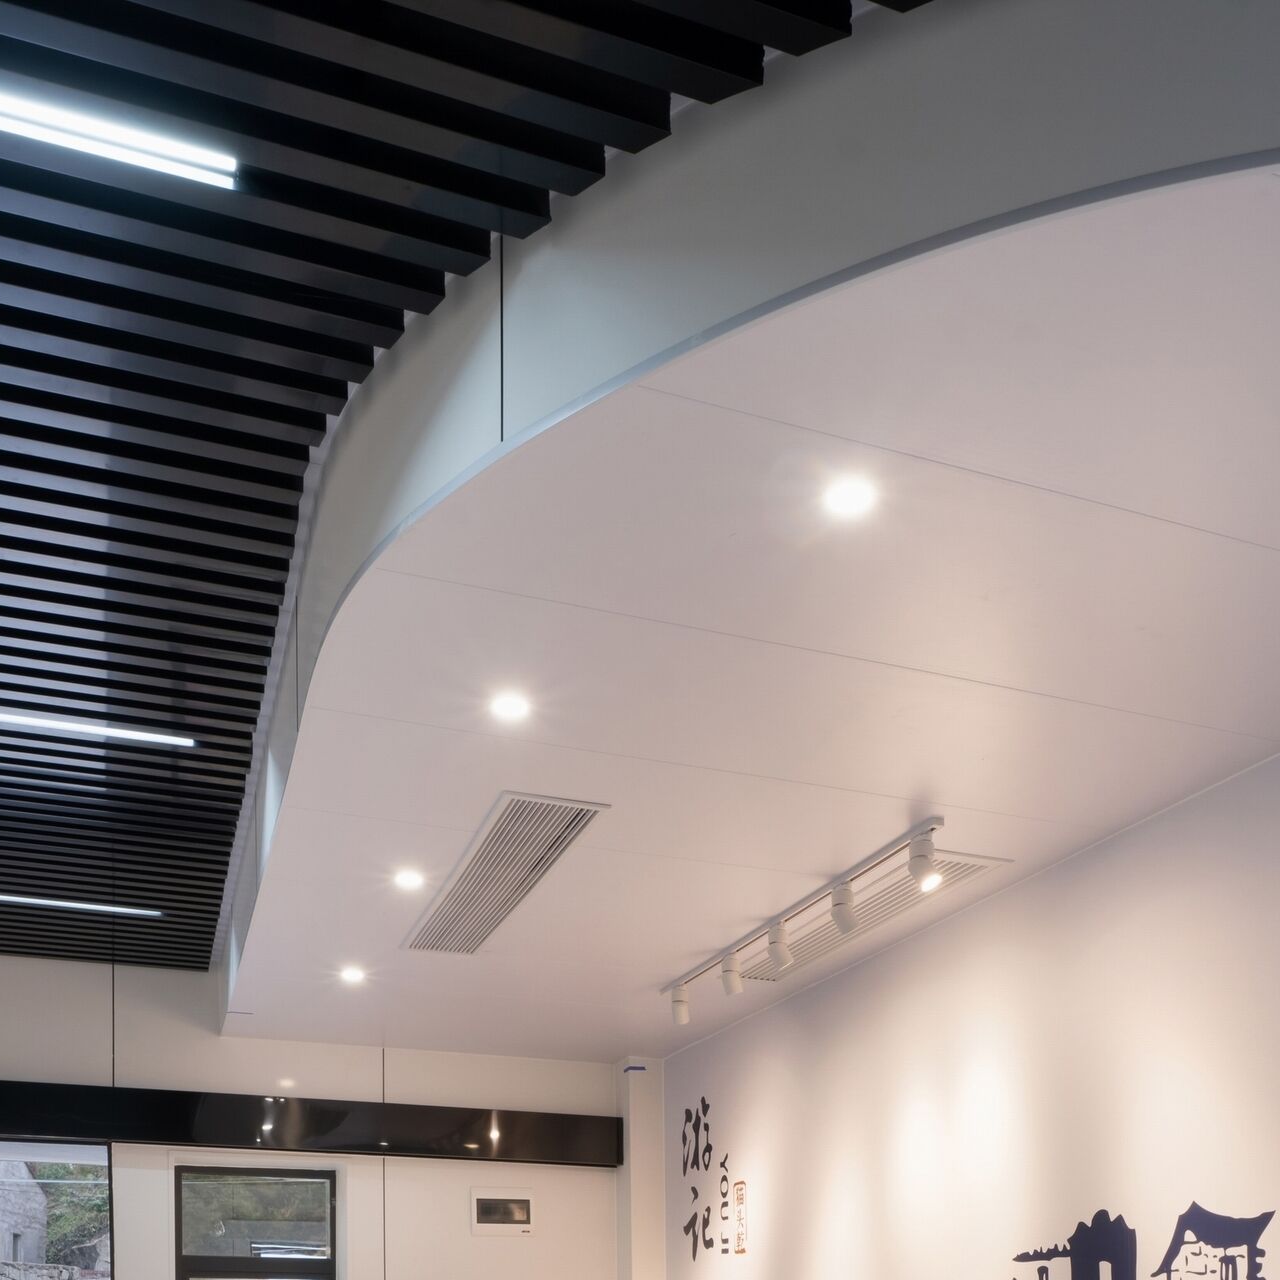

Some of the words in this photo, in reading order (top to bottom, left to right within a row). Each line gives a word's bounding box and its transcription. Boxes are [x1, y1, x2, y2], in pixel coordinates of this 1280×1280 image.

[682, 1096, 714, 1262] 游记
[720, 1153, 729, 1220] YOU
[721, 1232, 729, 1254] JI
